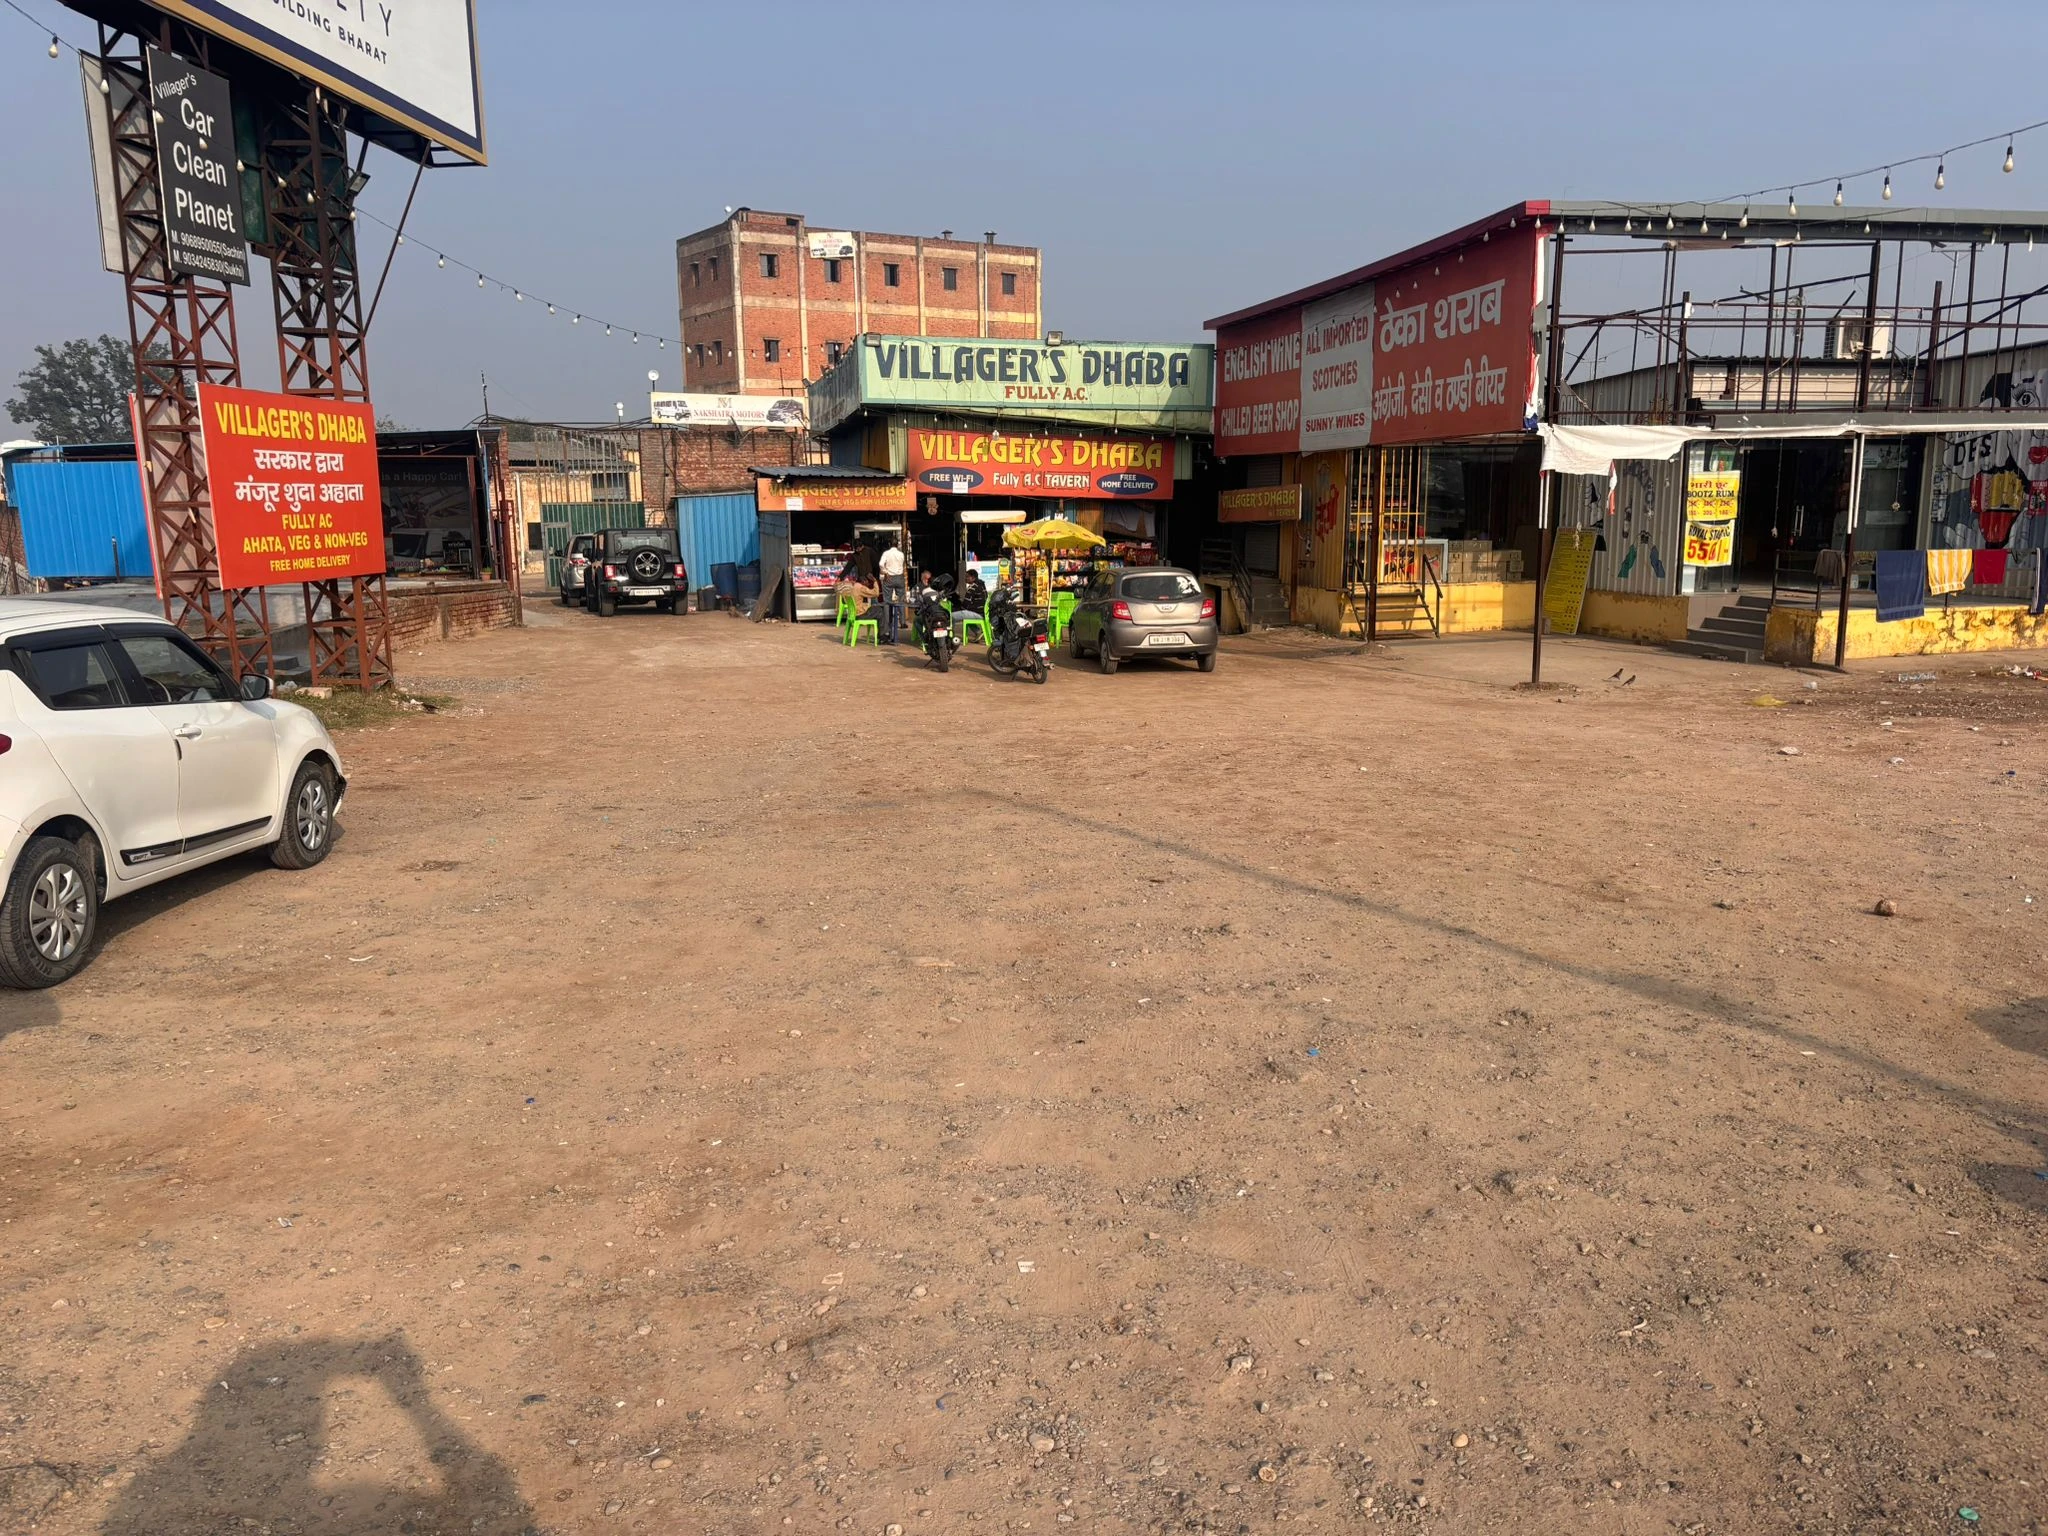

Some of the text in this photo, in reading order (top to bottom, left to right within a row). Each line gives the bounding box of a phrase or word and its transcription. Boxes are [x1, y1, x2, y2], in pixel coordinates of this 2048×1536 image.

[338, 26, 387, 64] BHARAT
[155, 72, 197, 99] Villager's
[181, 98, 215, 138] Car
[173, 141, 226, 187] Clean
[175, 187, 236, 233] Planet
[171, 229, 180, 245] M.
[173, 248, 182, 264] M.
[1380, 278, 1505, 352] ठेका शराब
[1306, 316, 1369, 355] ALL IMPORTED
[875, 345, 1069, 384] VILLAGER'S
[1083, 350, 1189, 388] DHABA
[1224, 331, 1301, 383] ENGLISH WINE
[1312, 360, 1358, 392] SCOTCHES
[1475, 355, 1508, 406] बीयर
[1004, 385, 1088, 401] FULLY A.C.
[214, 401, 367, 443] VILLAGER'S DHABA
[694, 409, 765, 419] NAKSHATRA MOTORS
[1221, 398, 1299, 437] CHILLED BEER SHOP
[1306, 412, 1365, 432] SUNNY WINES
[253, 449, 344, 473] सरकार द्वारा
[918, 433, 1162, 470] VILLAGER'S DHABA
[403, 471, 437, 482] Happy
[929, 473, 974, 483] FREE WI-FI
[993, 472, 1019, 488] Fully
[1045, 474, 1089, 487] TAVERN
[1123, 481, 1154, 490] DELIVERY
[234, 475, 364, 512] मंजूर शुदा अहाता
[769, 483, 906, 497] VILLAGER'S DHABA
[1222, 489, 1296, 508] VILLAGER'S DHABA
[282, 513, 333, 530] FULLY AC
[1688, 525, 1707, 540] ROYAL
[243, 532, 368, 554] AHATA, VEG & NON-VEG
[270, 555, 350, 572] FREE HOME DELIVERY
